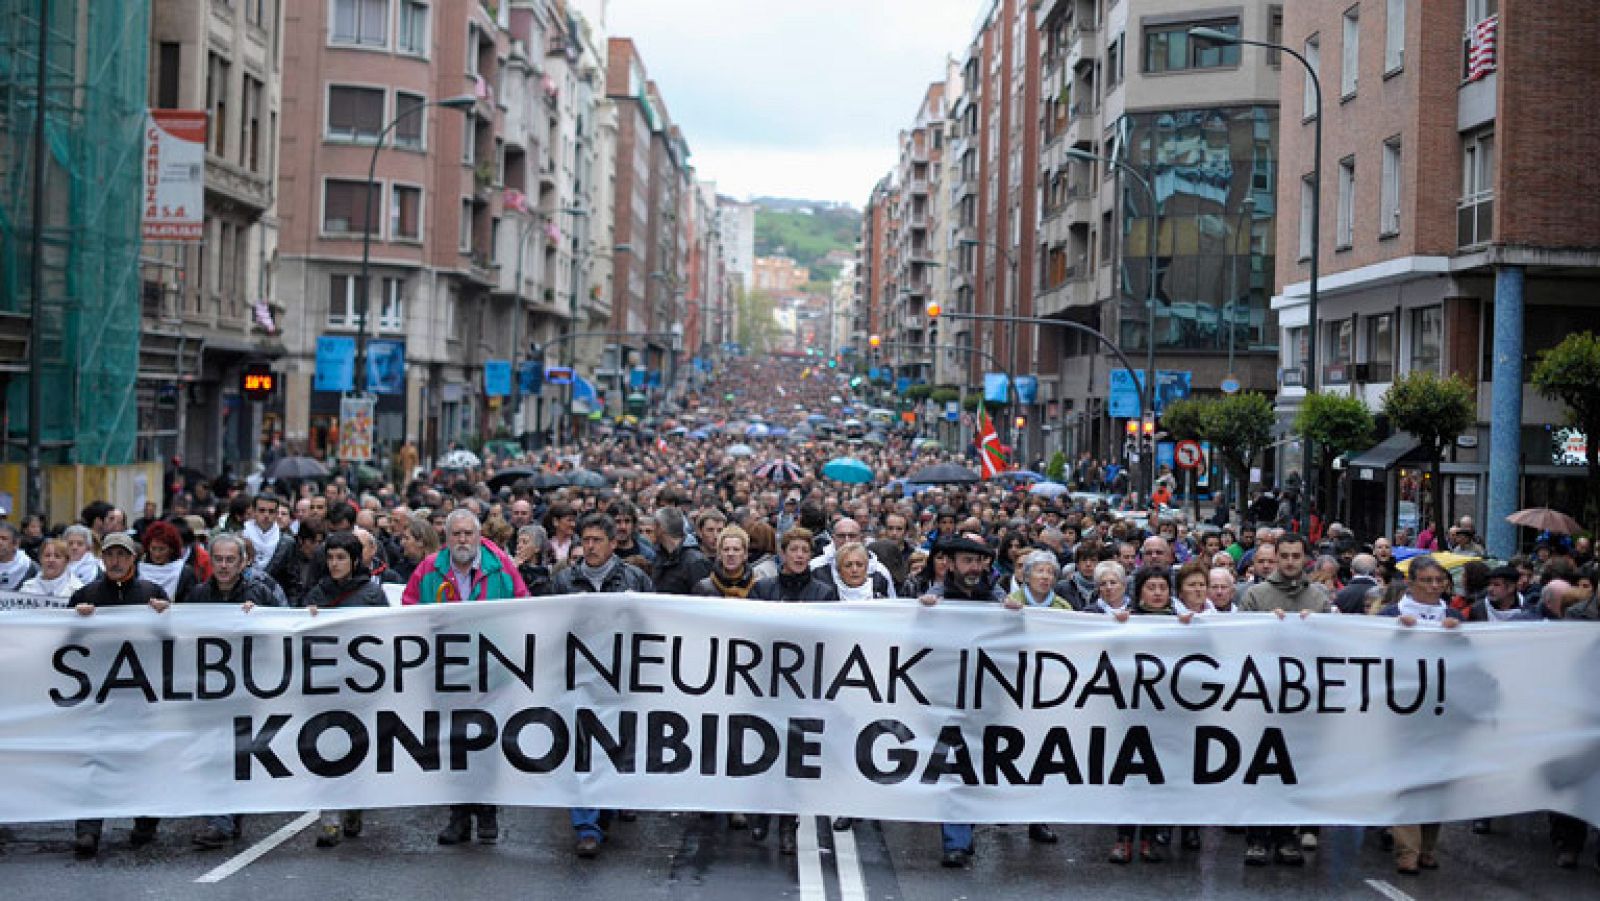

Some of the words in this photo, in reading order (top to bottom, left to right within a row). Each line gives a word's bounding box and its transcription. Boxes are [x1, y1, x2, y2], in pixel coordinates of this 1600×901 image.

[49, 633, 536, 708] SALBUESPEN
[565, 631, 934, 706] NEURRIAK
[955, 647, 1447, 717] INDARGABETU!
[232, 706, 825, 781] KONPONBIDE
[855, 719, 1166, 787] GARAIA
[1193, 725, 1299, 786] DA
